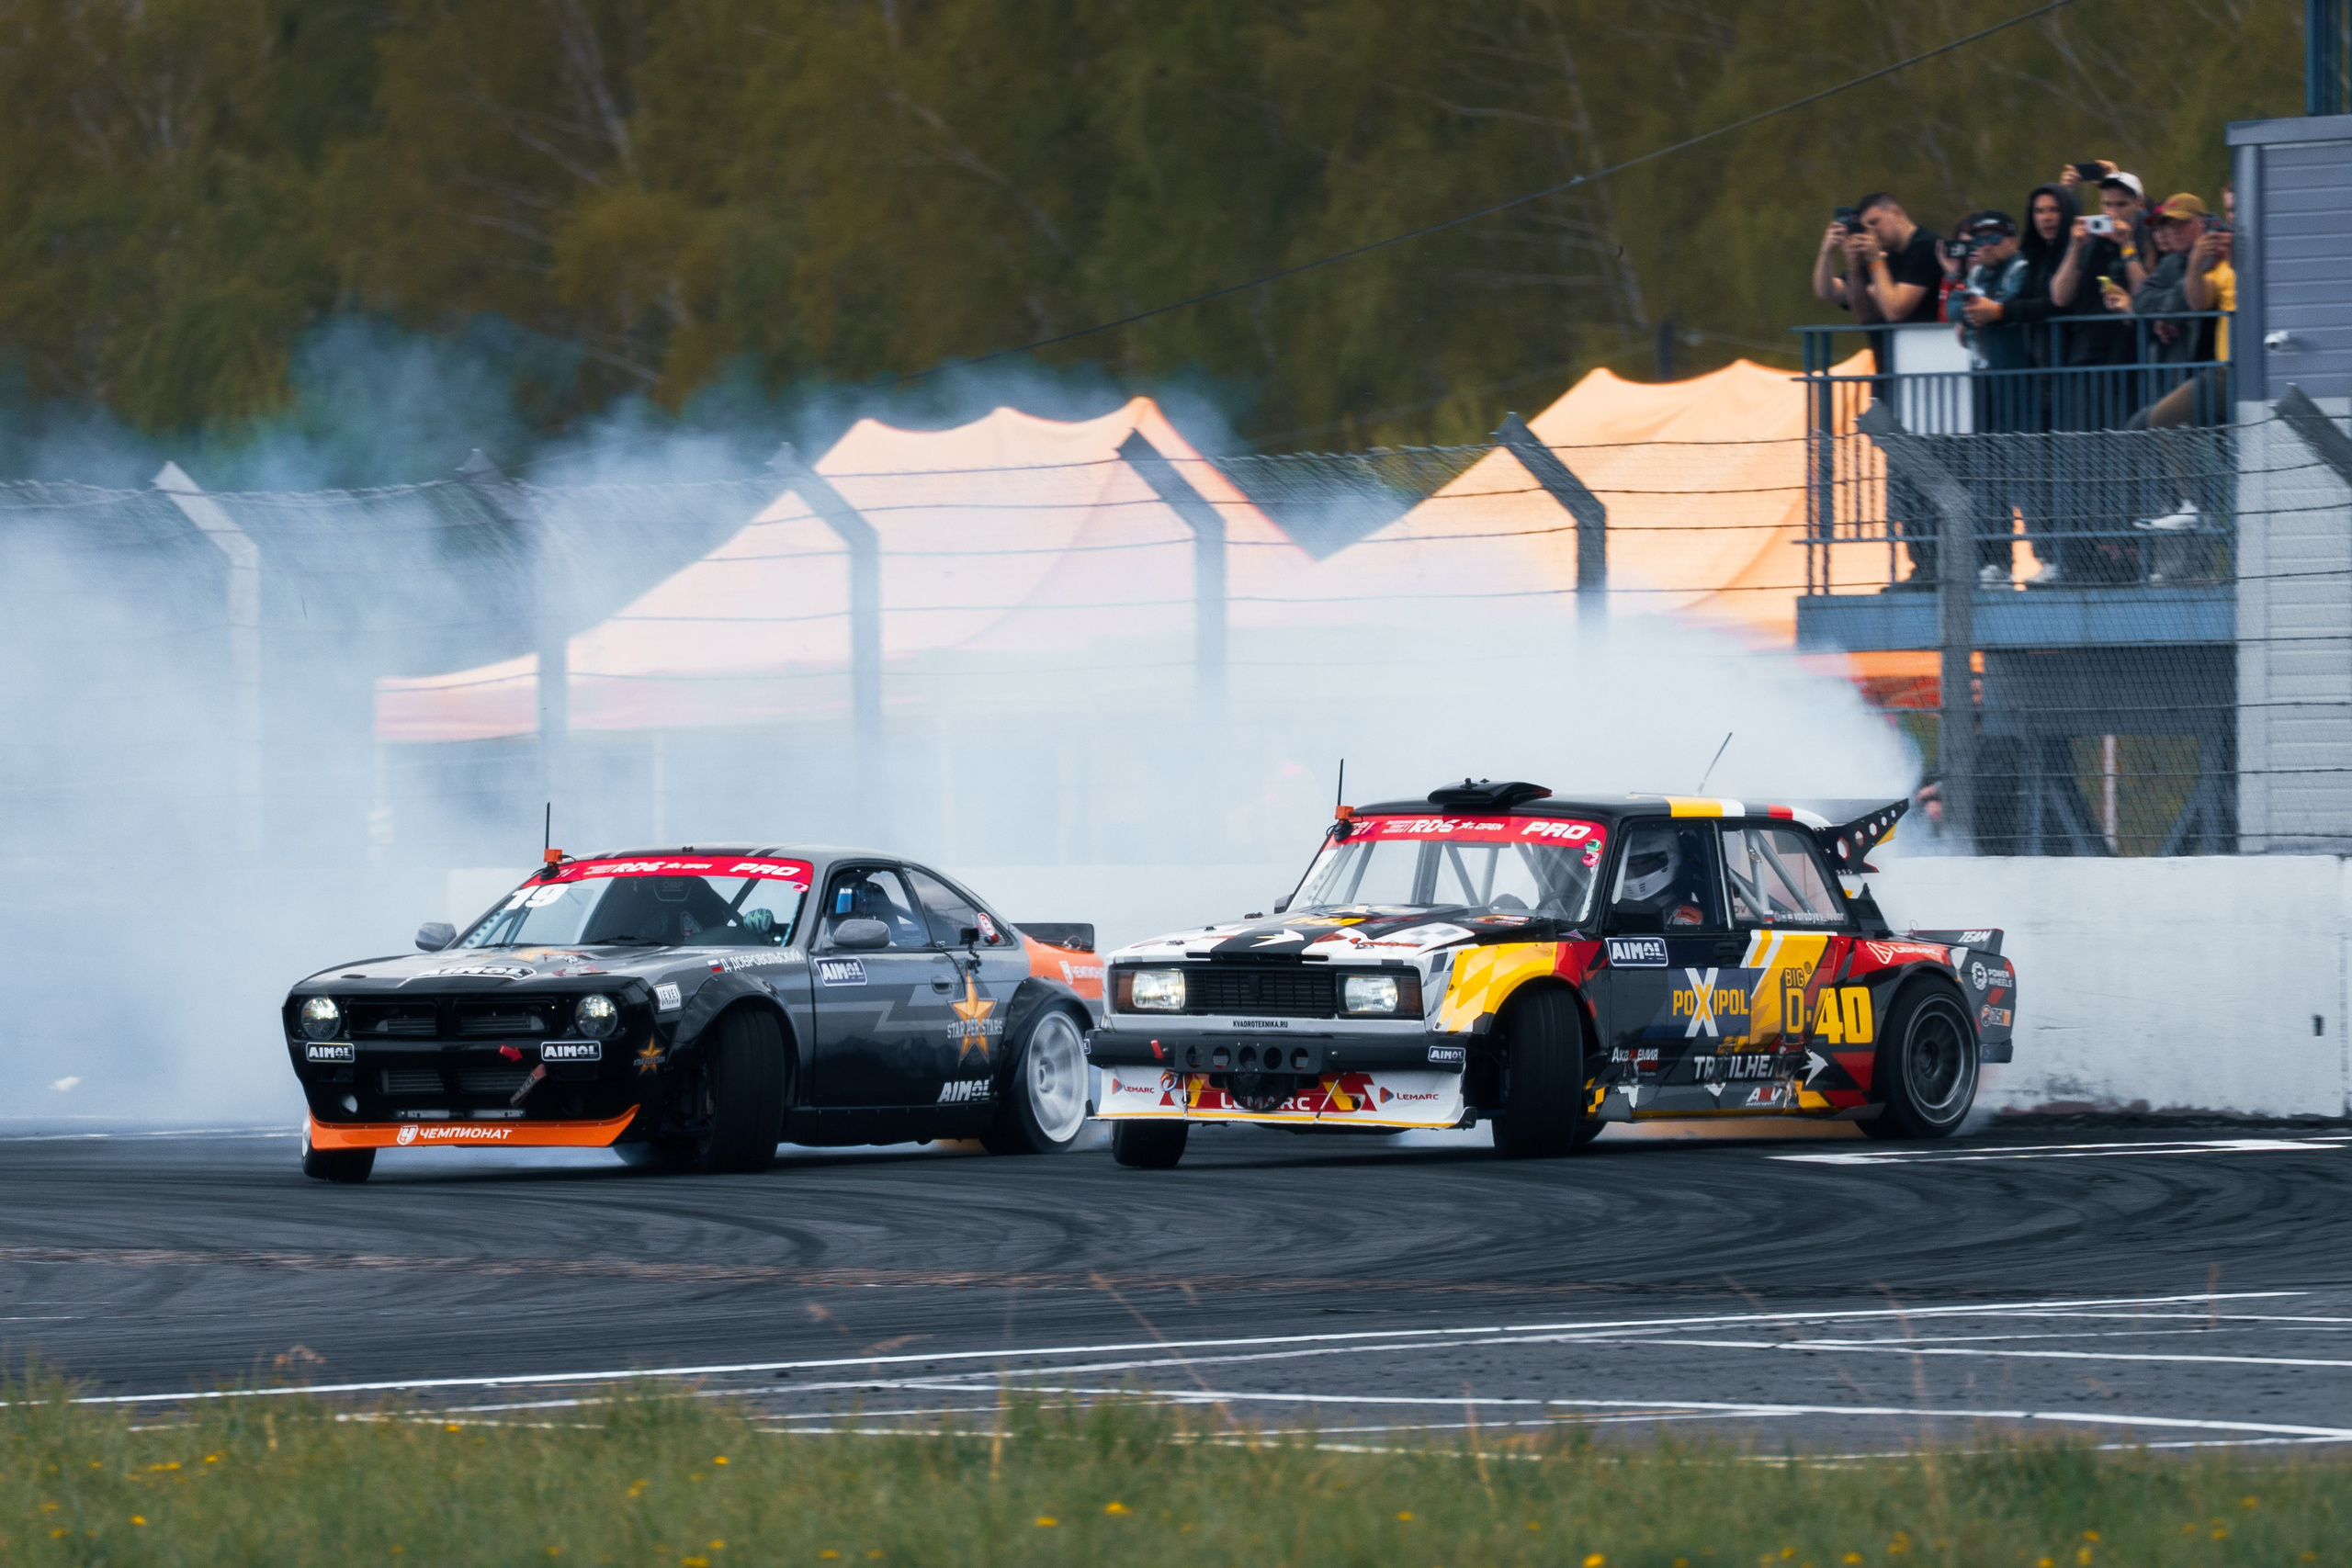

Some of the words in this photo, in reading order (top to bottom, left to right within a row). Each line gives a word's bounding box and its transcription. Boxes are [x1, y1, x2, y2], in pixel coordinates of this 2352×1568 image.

[1408, 820, 1460, 833] RDS
[1474, 822, 1506, 830] OPEN
[1521, 821, 1591, 840] PRO
[729, 863, 801, 876] PRO
[503, 884, 570, 910] 19
[1958, 931, 1992, 943] TEAM
[1612, 942, 1665, 960] AIMOL
[730, 949, 805, 972] ДОБРОВОЛЬСКИЙ
[821, 962, 864, 980] AIMOL
[1784, 968, 1804, 987] BIG
[1987, 969, 2009, 978] POWER
[1989, 977, 2013, 987] WHEELS
[1673, 967, 1749, 1037] POXIPOL
[1785, 987, 1874, 1043] D-40
[947, 1021, 965, 1039] STAR
[967, 1019, 979, 1037] PER
[981, 1018, 1003, 1036] STARS
[309, 1045, 351, 1058] AIMOL
[544, 1045, 597, 1057] AIMOL
[1430, 1050, 1464, 1060] AIMOL
[1611, 1047, 1659, 1063] АкаЕМИЯ
[937, 1079, 990, 1102] AIMOL
[1123, 1084, 1155, 1093] LEMARC
[1396, 1092, 1440, 1101] LEMARC
[420, 1127, 513, 1140] ЧЕМПИОНАТ
